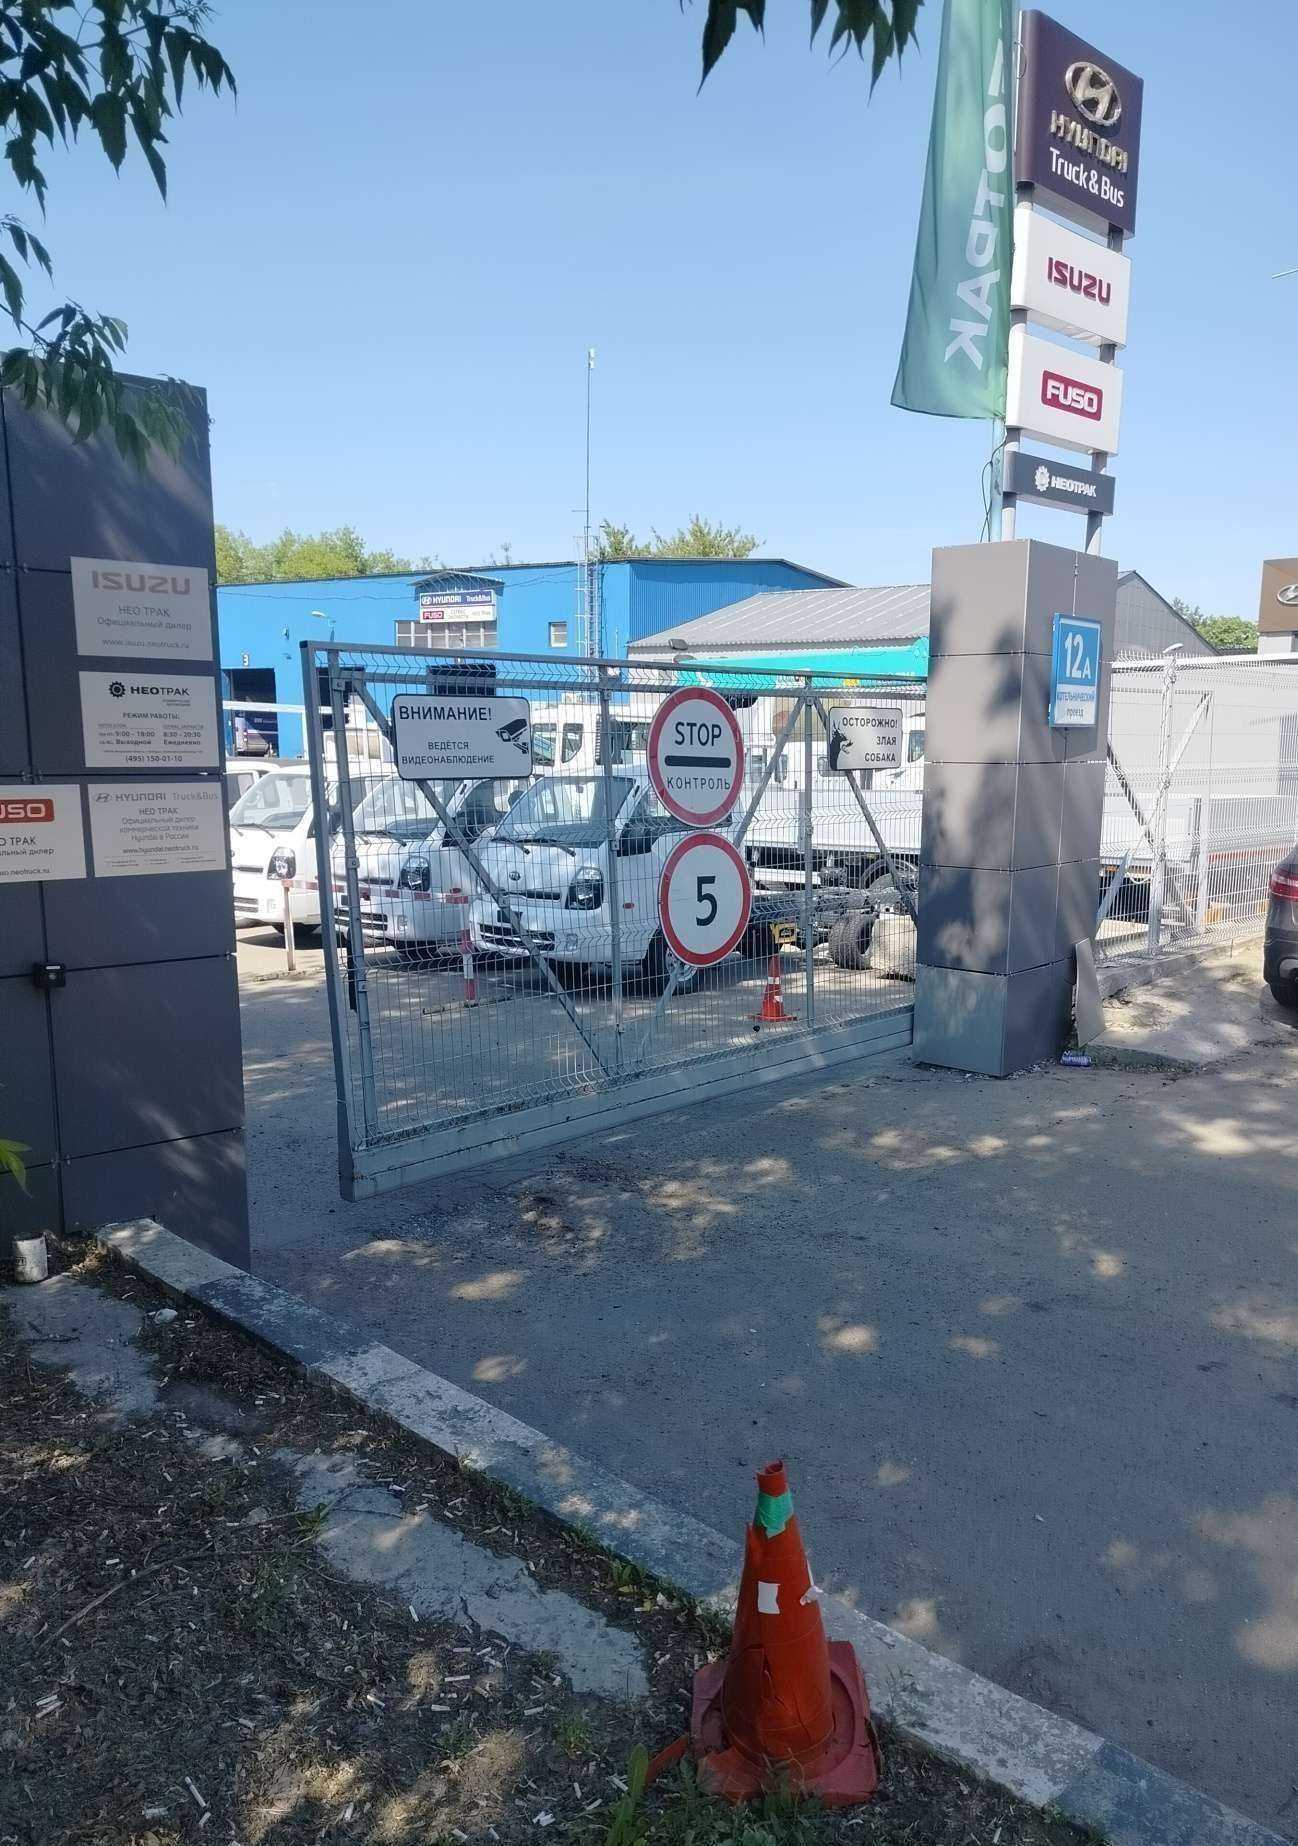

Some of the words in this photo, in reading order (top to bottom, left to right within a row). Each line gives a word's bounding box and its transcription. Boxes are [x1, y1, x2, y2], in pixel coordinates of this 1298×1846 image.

[1050, 110, 1128, 174] HYUNDAI
[1047, 257, 1112, 305] ISUZU
[1046, 378, 1098, 414] FUSO
[1051, 475, 1097, 498] НЕОТРАК
[92, 570, 191, 595] ISUZU
[432, 595, 462, 605] HYUNDAI
[118, 605, 141, 616] НЕО
[143, 606, 171, 617] ТРАК
[130, 685, 190, 697] НЕОТРАК
[399, 705, 493, 721] ВНИМАНИЕ!
[842, 716, 899, 730] ОСТОРОЖНО!
[674, 721, 722, 747] STOP
[876, 736, 897, 746] ЗЛАЯ
[401, 755, 496, 766] ВИДЕОНАБЛЮДЕНИЕ
[864, 752, 897, 763] СОБАКА
[666, 776, 731, 791] КОНТРОЛЬ
[115, 791, 166, 802] HYUNDAI
[157, 807, 178, 815] ТРАК
[9, 836, 36, 846] ТРАК
[695, 875, 718, 927] 5
